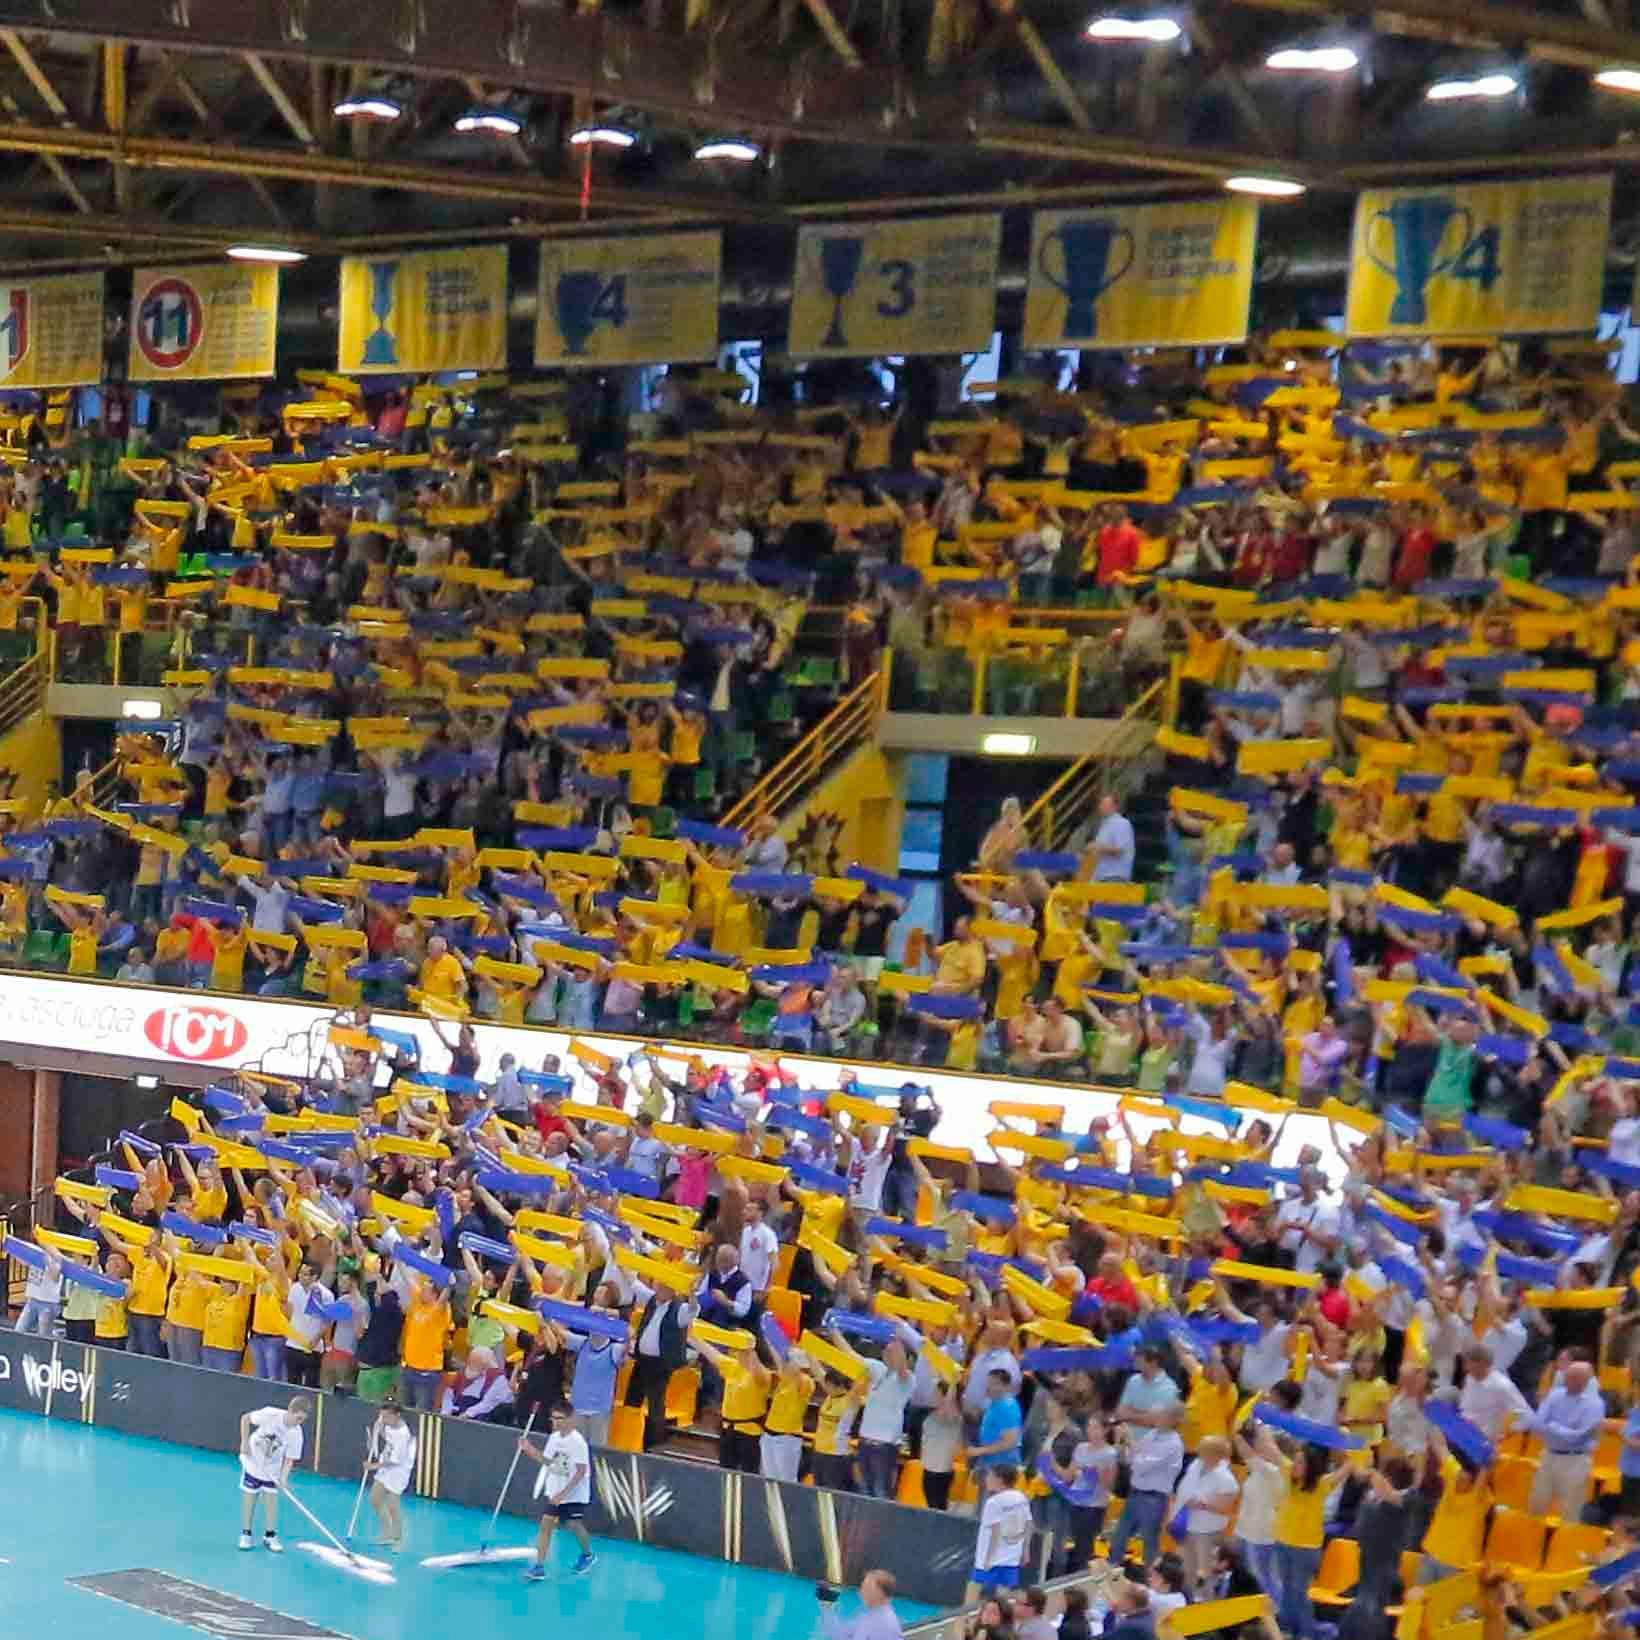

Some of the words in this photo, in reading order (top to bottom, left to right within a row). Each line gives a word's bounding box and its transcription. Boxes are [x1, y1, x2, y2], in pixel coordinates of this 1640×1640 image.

[1452, 226, 1503, 292] 4
[590, 274, 628, 328] 4
[876, 259, 916, 319] 3
[142, 299, 190, 347] 11
